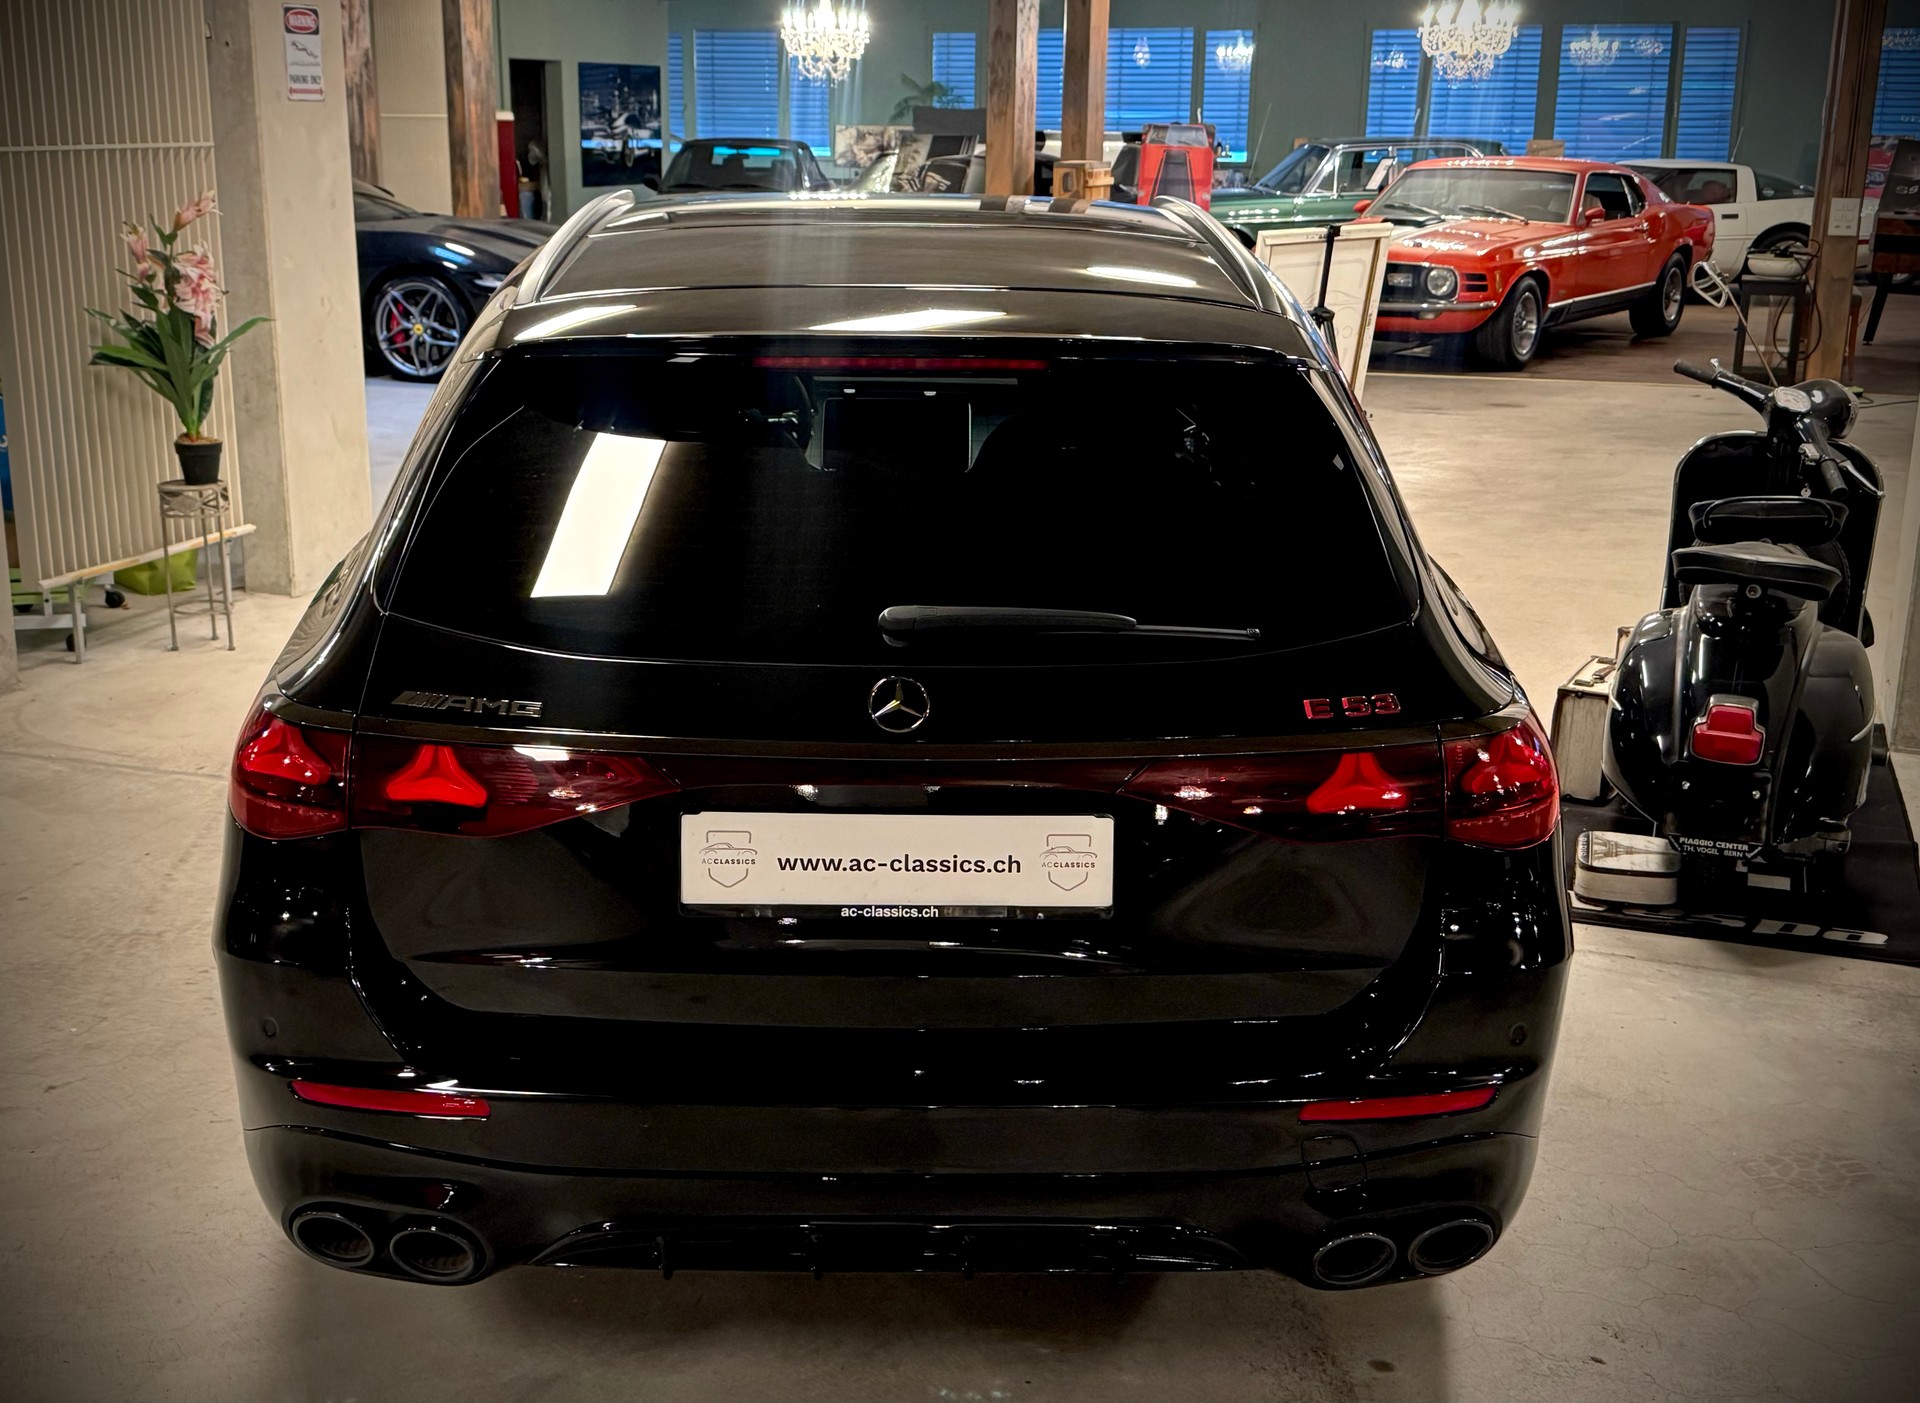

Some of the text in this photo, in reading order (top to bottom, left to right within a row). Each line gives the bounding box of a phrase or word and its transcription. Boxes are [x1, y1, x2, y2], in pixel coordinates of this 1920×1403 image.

[1303, 693, 1401, 720] E 53
[1679, 837, 1749, 851] PIAGGIO CENTER
[1697, 847, 1719, 855] VOGEL
[777, 854, 1021, 873] www.ac-classics.ch
[840, 905, 939, 918] ac-classics.ch
